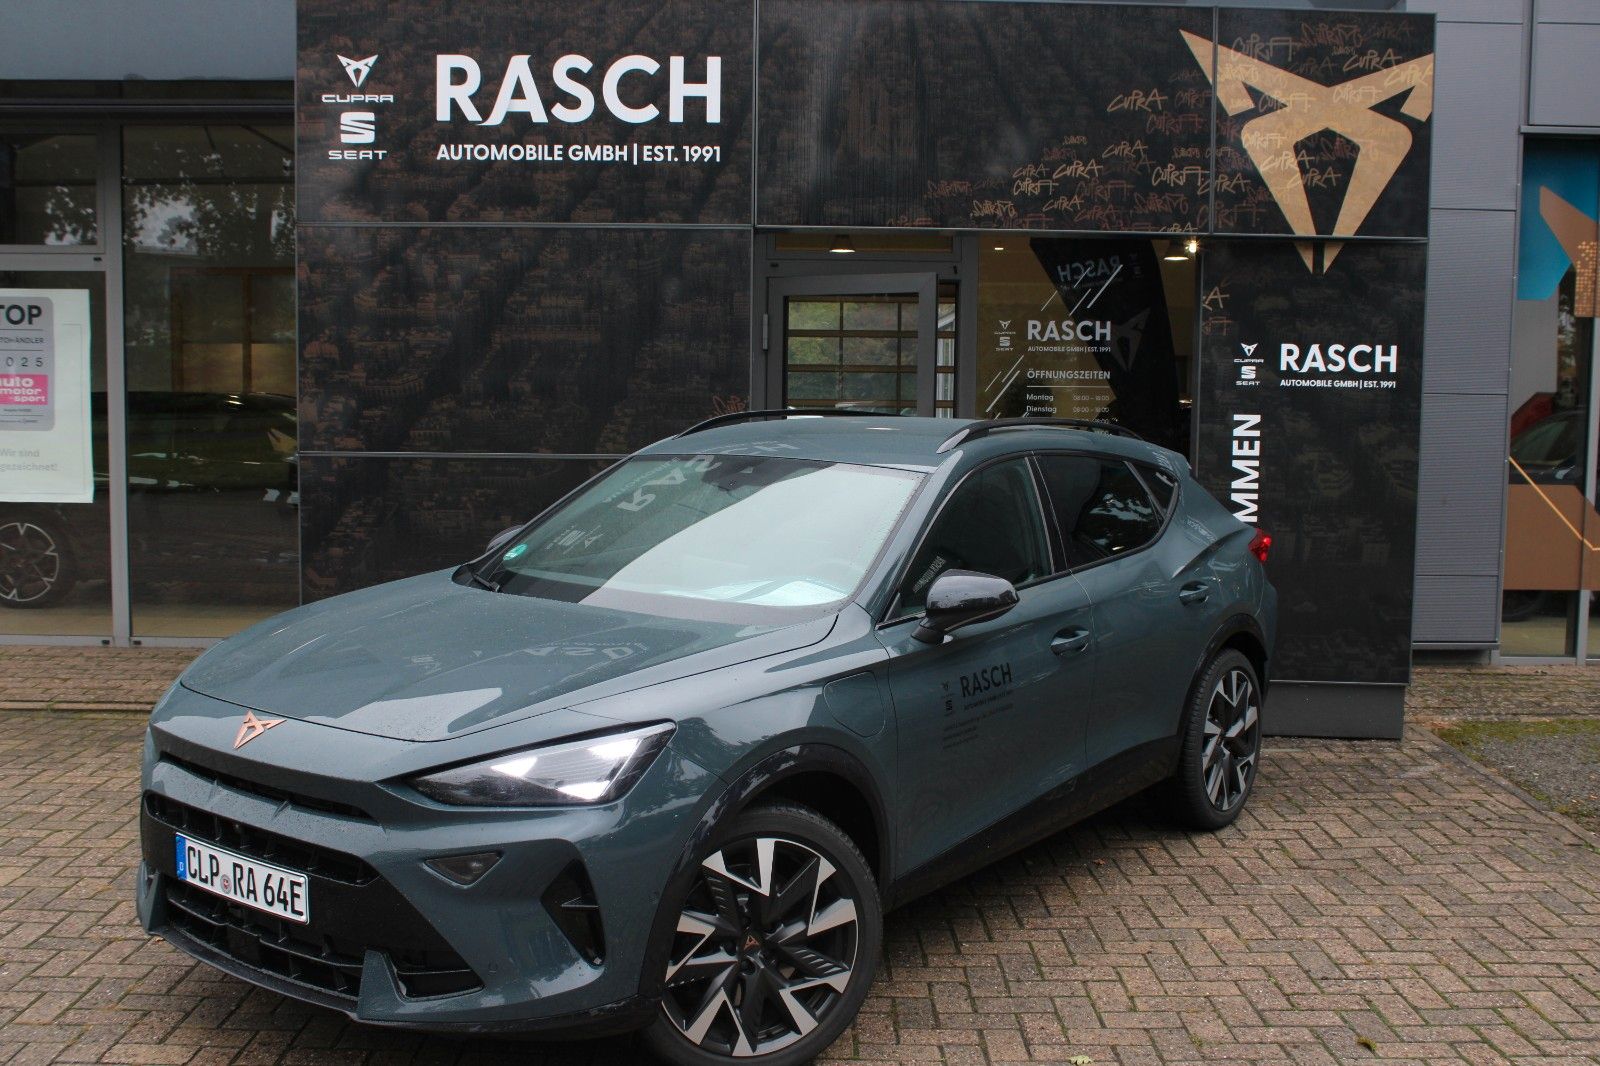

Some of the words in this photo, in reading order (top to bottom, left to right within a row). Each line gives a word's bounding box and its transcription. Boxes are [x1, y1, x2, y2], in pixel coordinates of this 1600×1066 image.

[321, 94, 394, 103] CUPRA
[436, 53, 722, 126] RASCH
[1107, 88, 1168, 112] CUPRA
[328, 150, 387, 160] SEAT
[436, 144, 563, 161] AUTOMOBILE
[568, 144, 628, 162] GMBH
[643, 145, 679, 162] EST.
[682, 146, 721, 163] 1991
[1052, 158, 1104, 180] CUPRA
[0, 304, 43, 325] OP
[1027, 320, 1111, 342] RASCH
[1280, 343, 1397, 373] RASCH
[0, 377, 33, 387] uto
[1027, 368, 1111, 380] ÖFFNUNGSZEITEN
[1280, 379, 1332, 388] AUTOMOBILE
[1333, 380, 1358, 389] GMBH
[1363, 380, 1379, 389] EST.
[1380, 381, 1396, 389] 1991
[1026, 393, 1054, 402] Montag
[1026, 405, 1057, 414] Dienstag
[959, 662, 1012, 697] RASCH
[187, 846, 220, 886] CLP
[232, 862, 258, 903] RA
[263, 873, 304, 917] 64E
